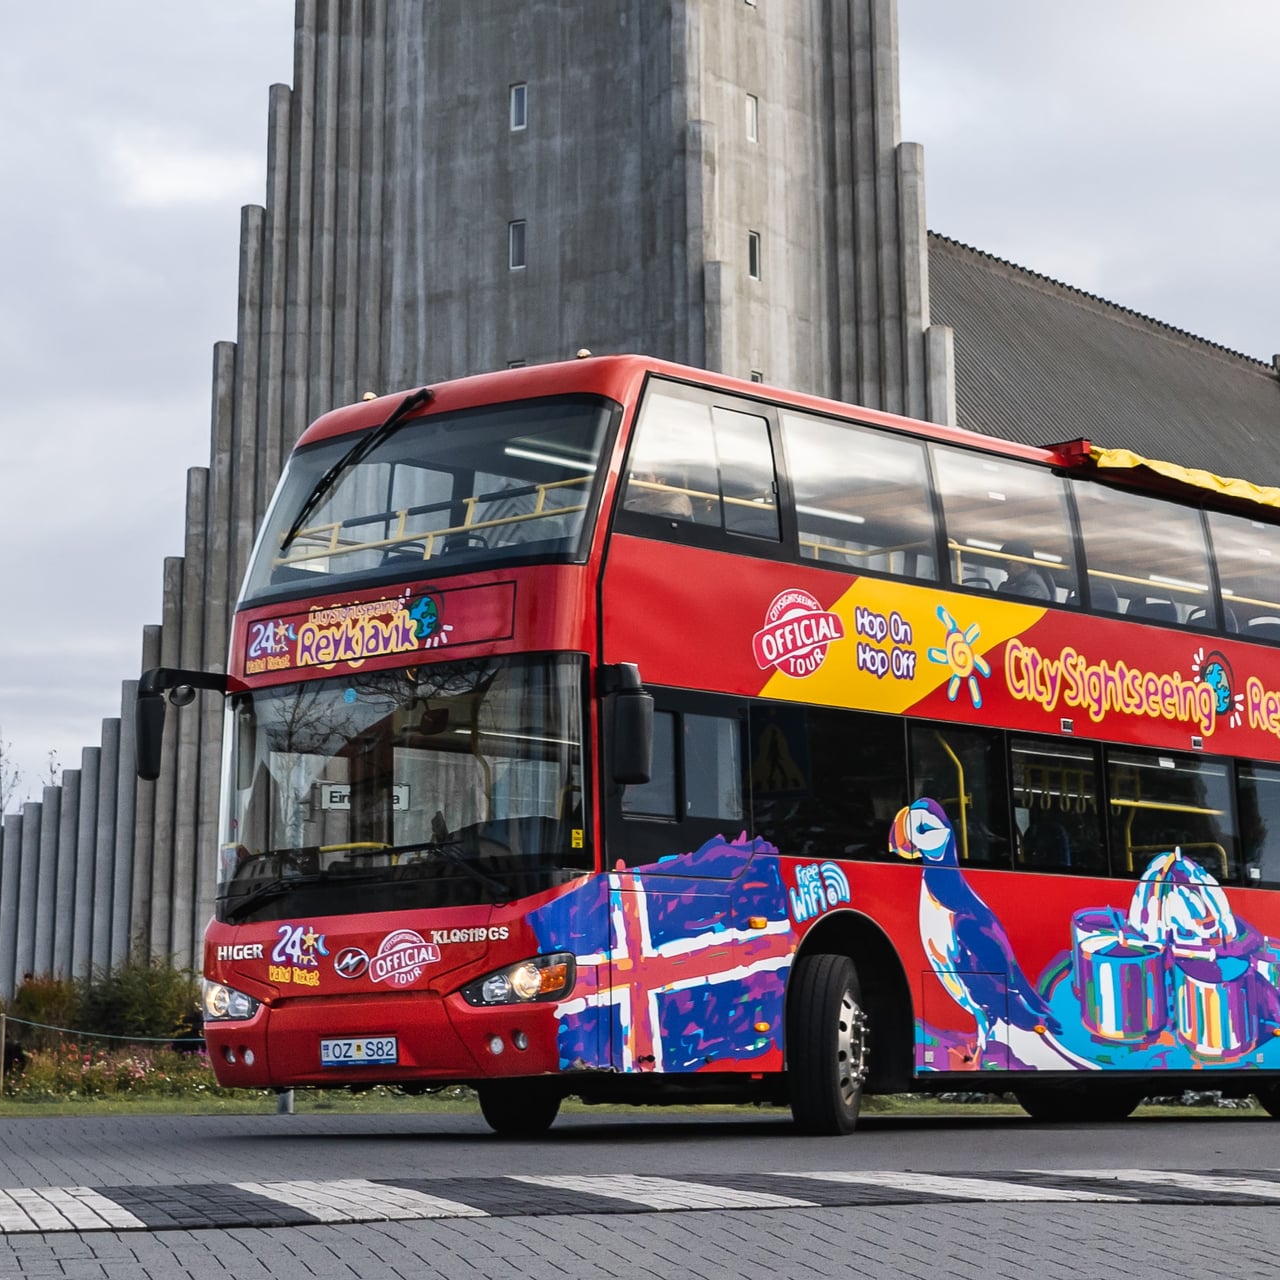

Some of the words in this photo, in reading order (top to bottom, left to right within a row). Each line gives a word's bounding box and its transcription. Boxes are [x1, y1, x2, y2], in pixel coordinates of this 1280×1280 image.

[761, 616, 841, 661] OFFICIAL
[856, 607, 888, 642] Hop
[890, 613, 912, 643] On
[297, 610, 418, 670] Reykjavik
[789, 648, 825, 675] TOUR
[858, 643, 889, 678] Hop
[891, 648, 916, 679] Off
[795, 863, 820, 886] Free
[217, 943, 264, 961] HIGER
[375, 946, 436, 976] OFFICIAL
[394, 966, 422, 984] TOUR
[332, 1042, 353, 1059] OZ
[365, 1040, 394, 1058] S82
